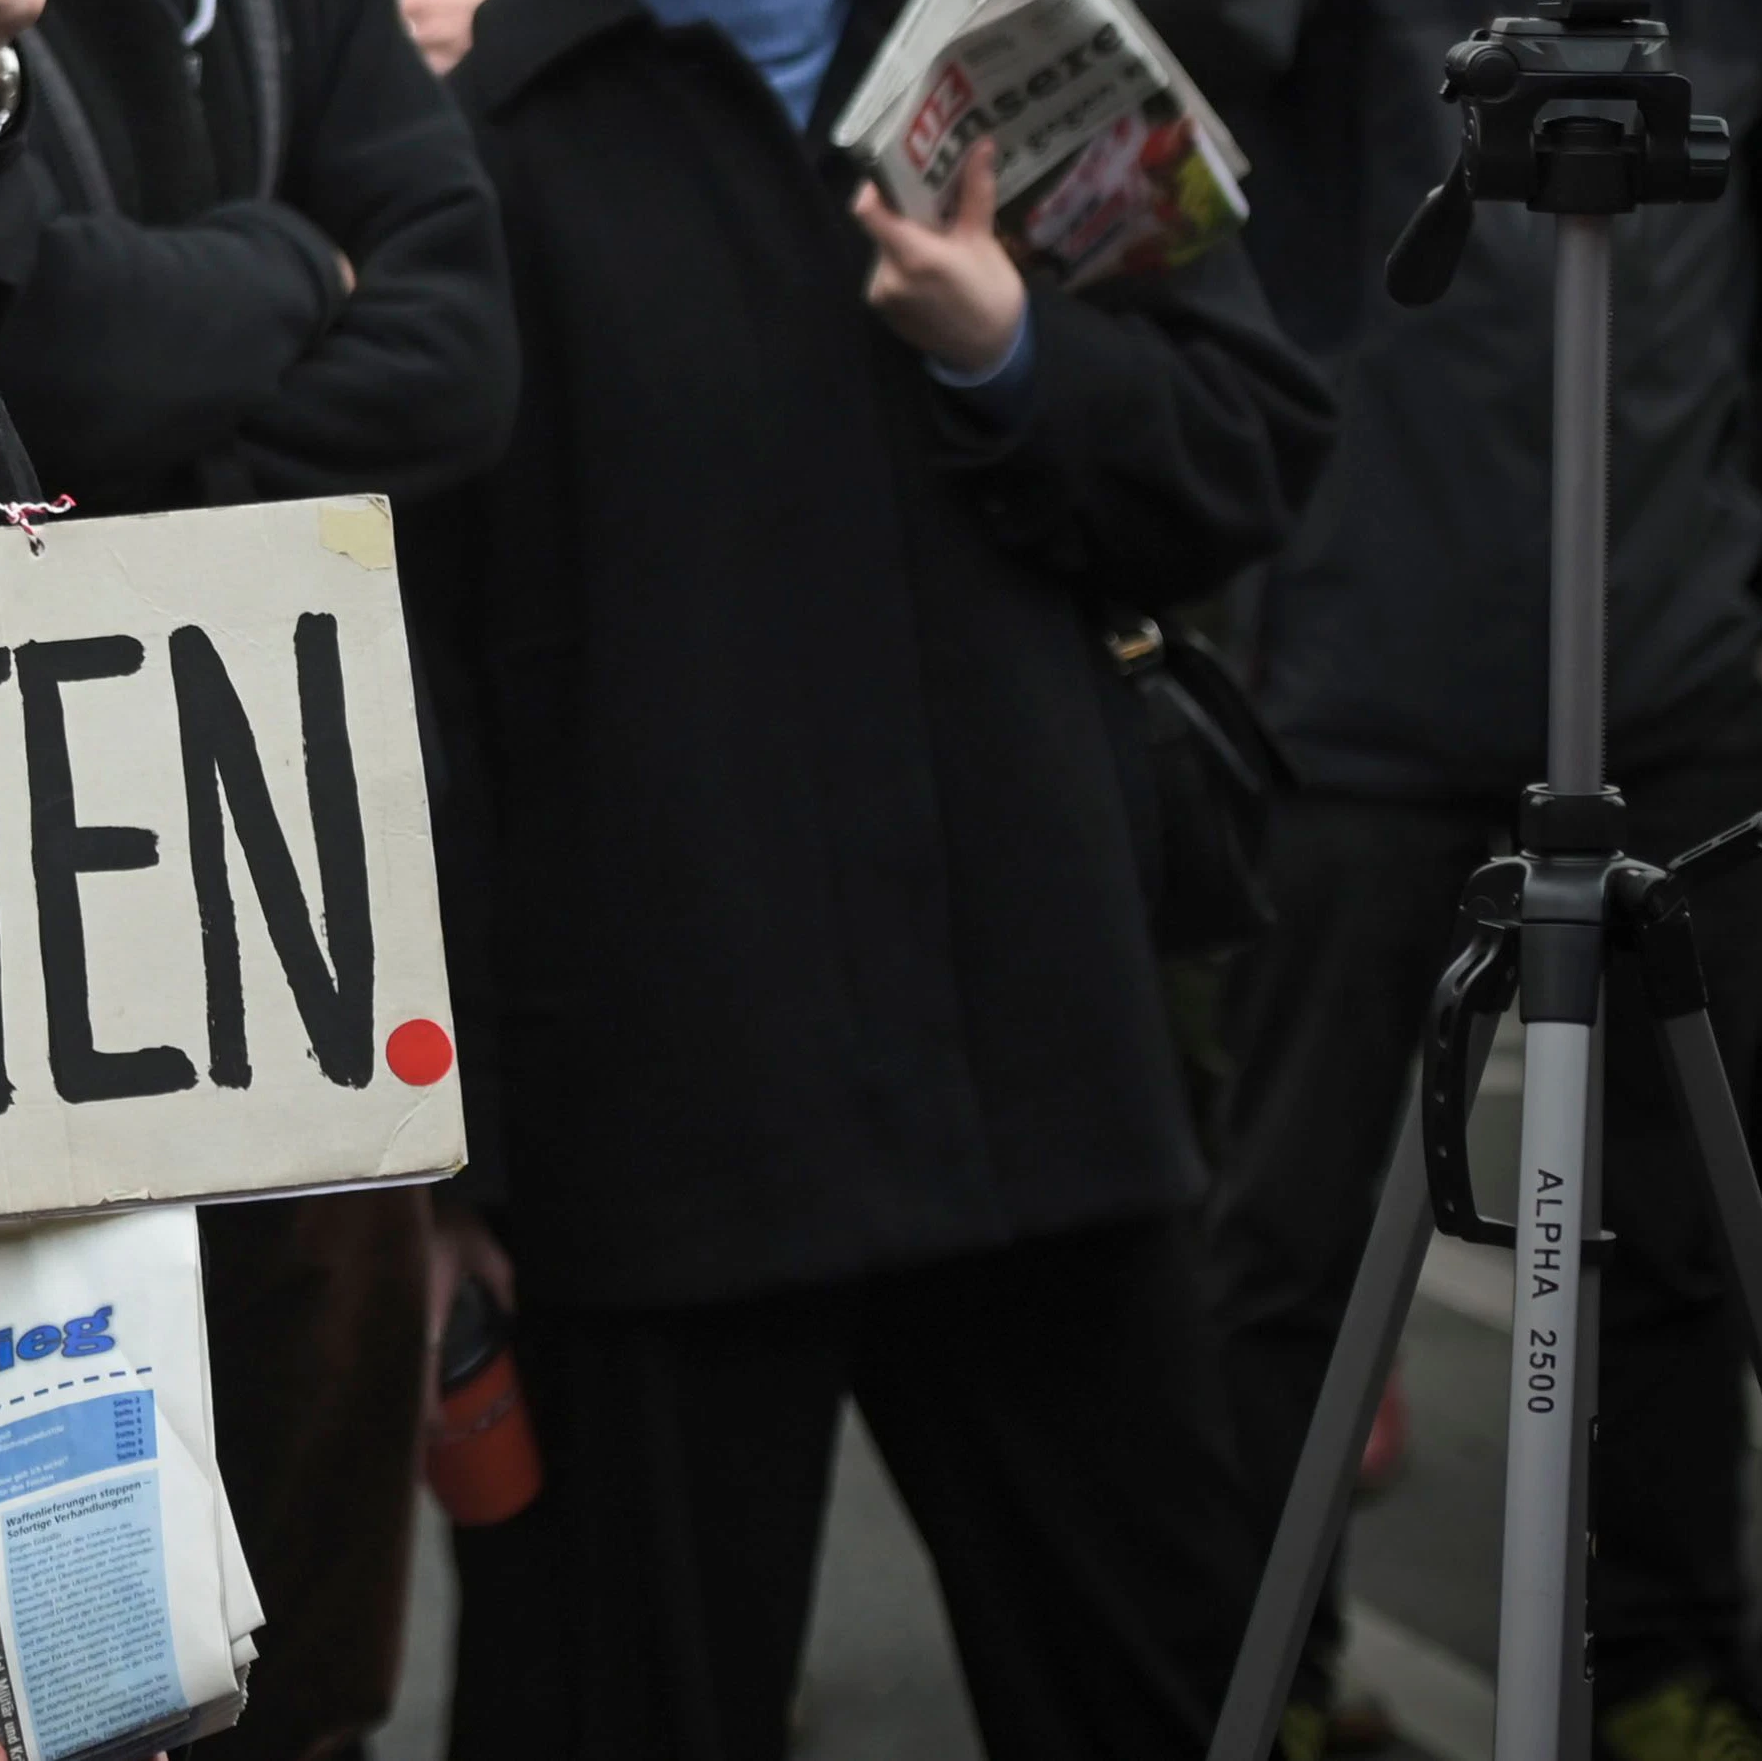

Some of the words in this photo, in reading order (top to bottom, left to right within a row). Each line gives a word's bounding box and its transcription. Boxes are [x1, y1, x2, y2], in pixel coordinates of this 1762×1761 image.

[1532, 1168, 1565, 1300] ALPHA
[1527, 1328, 1558, 1414] 2500
[6, 1492, 97, 1528] Waffenlieferungen
[99, 1481, 142, 1502] stoppen
[7, 1517, 53, 1540] Sofortige
[54, 1494, 135, 1525] Verhandlungen!
[3, 1723, 20, 1745] und
